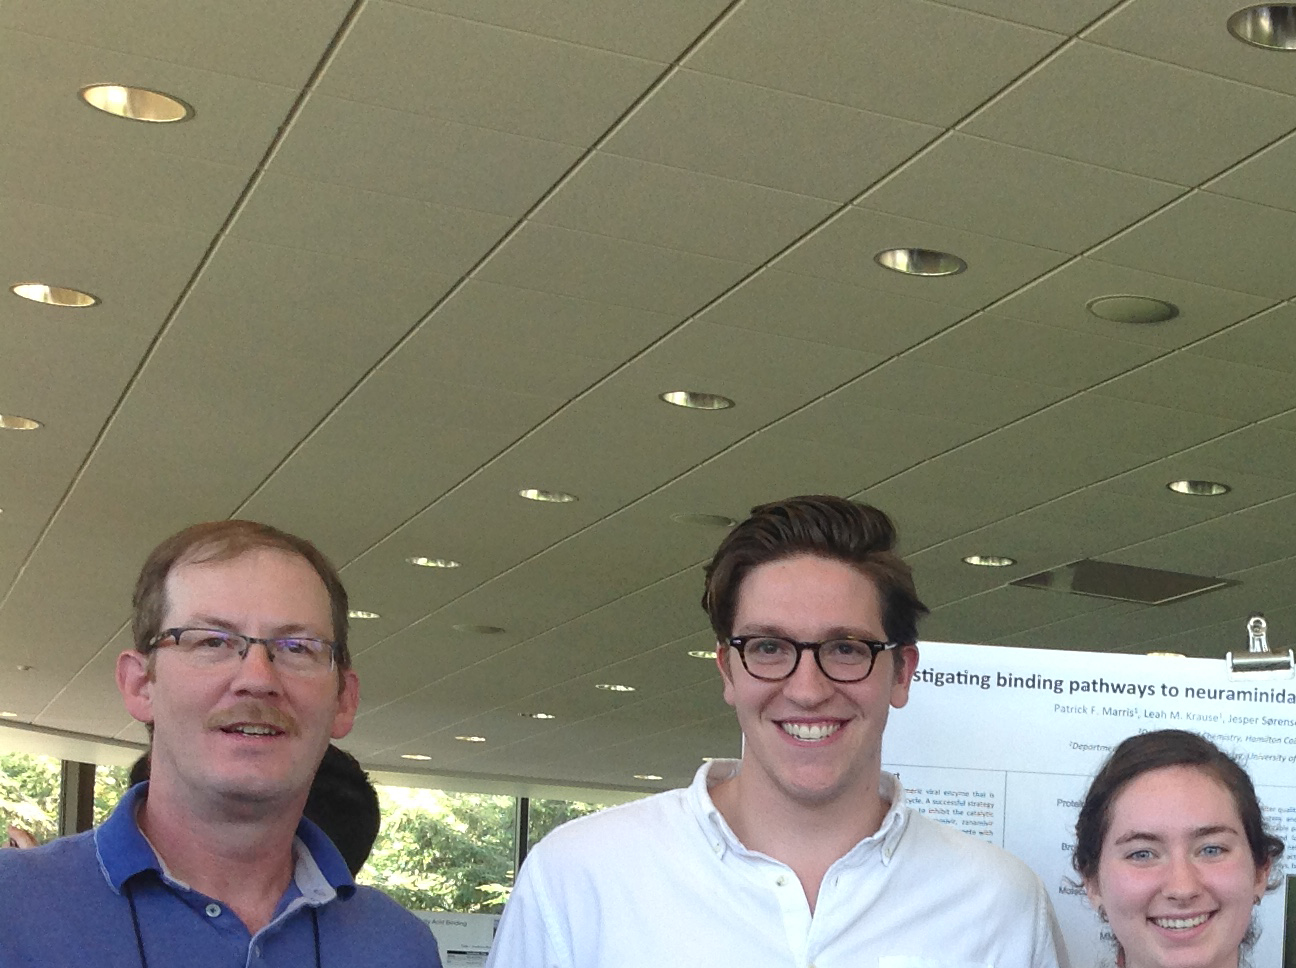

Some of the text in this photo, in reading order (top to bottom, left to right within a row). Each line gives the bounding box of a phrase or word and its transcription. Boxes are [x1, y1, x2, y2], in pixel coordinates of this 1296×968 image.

[913, 668, 991, 689] stigating
[997, 672, 1063, 694] binding
[1070, 678, 1155, 698] pathways
[1161, 683, 1179, 697] to
[1054, 704, 1087, 714] Patrick
[1091, 706, 1098, 715] F.
[1144, 709, 1166, 719] Leah
[1170, 711, 1182, 720] M.
[1228, 715, 1258, 726] Jesper
[1246, 735, 1281, 744] Hamilton
[1248, 753, 1286, 763] University
[1289, 755, 1296, 764] of
